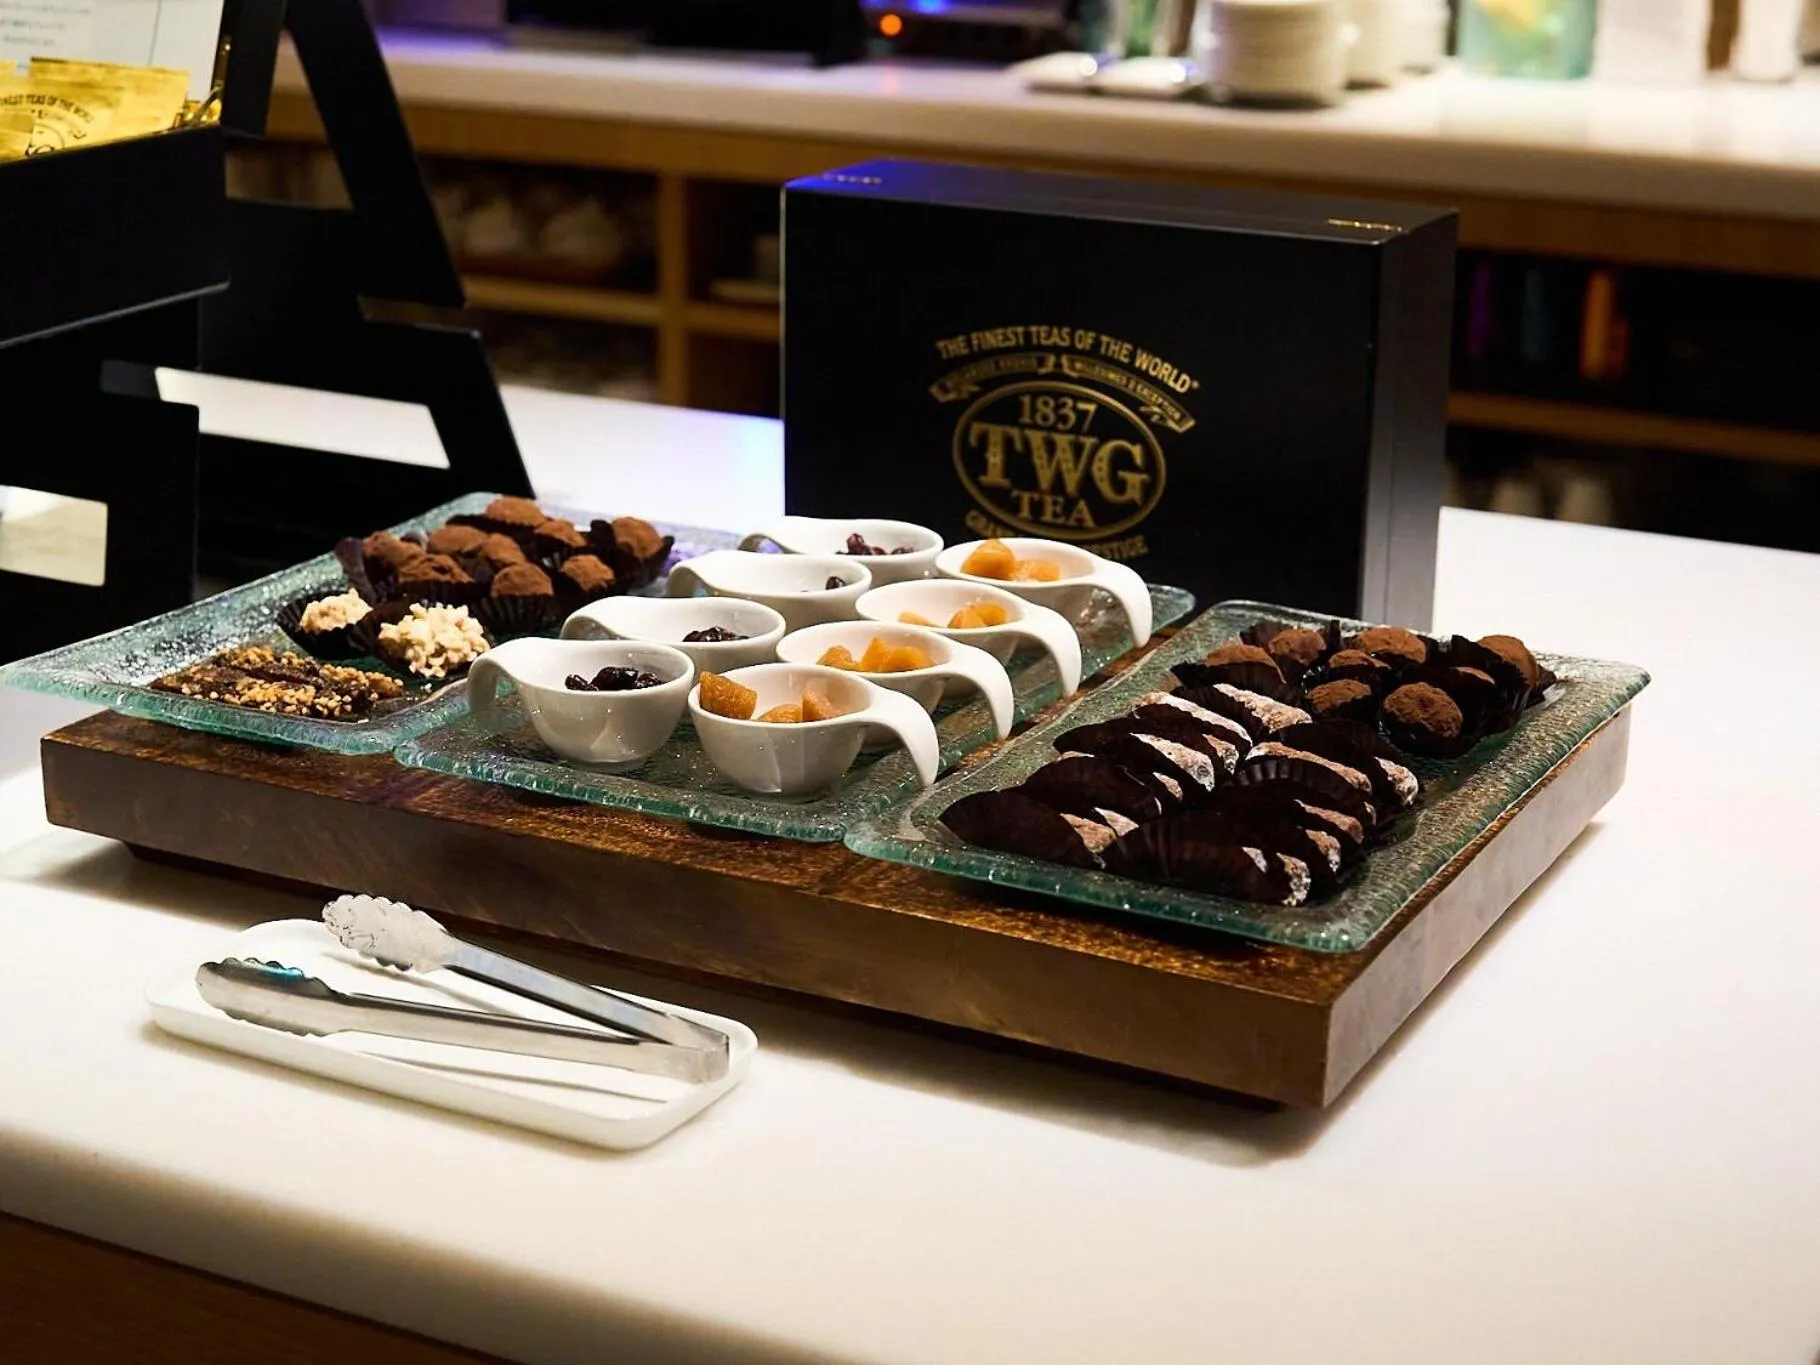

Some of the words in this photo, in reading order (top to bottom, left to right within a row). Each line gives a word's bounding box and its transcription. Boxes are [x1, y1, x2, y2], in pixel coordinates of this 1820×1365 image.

[936, 334, 970, 360] THE
[970, 325, 1026, 353] FINEST
[1028, 324, 1072, 347] TEAS
[1073, 328, 1096, 350] OF
[1100, 334, 1133, 364] THE
[1018, 394, 1098, 432] 1837
[968, 421, 1150, 504] TWG
[1011, 490, 1097, 528] TEA
